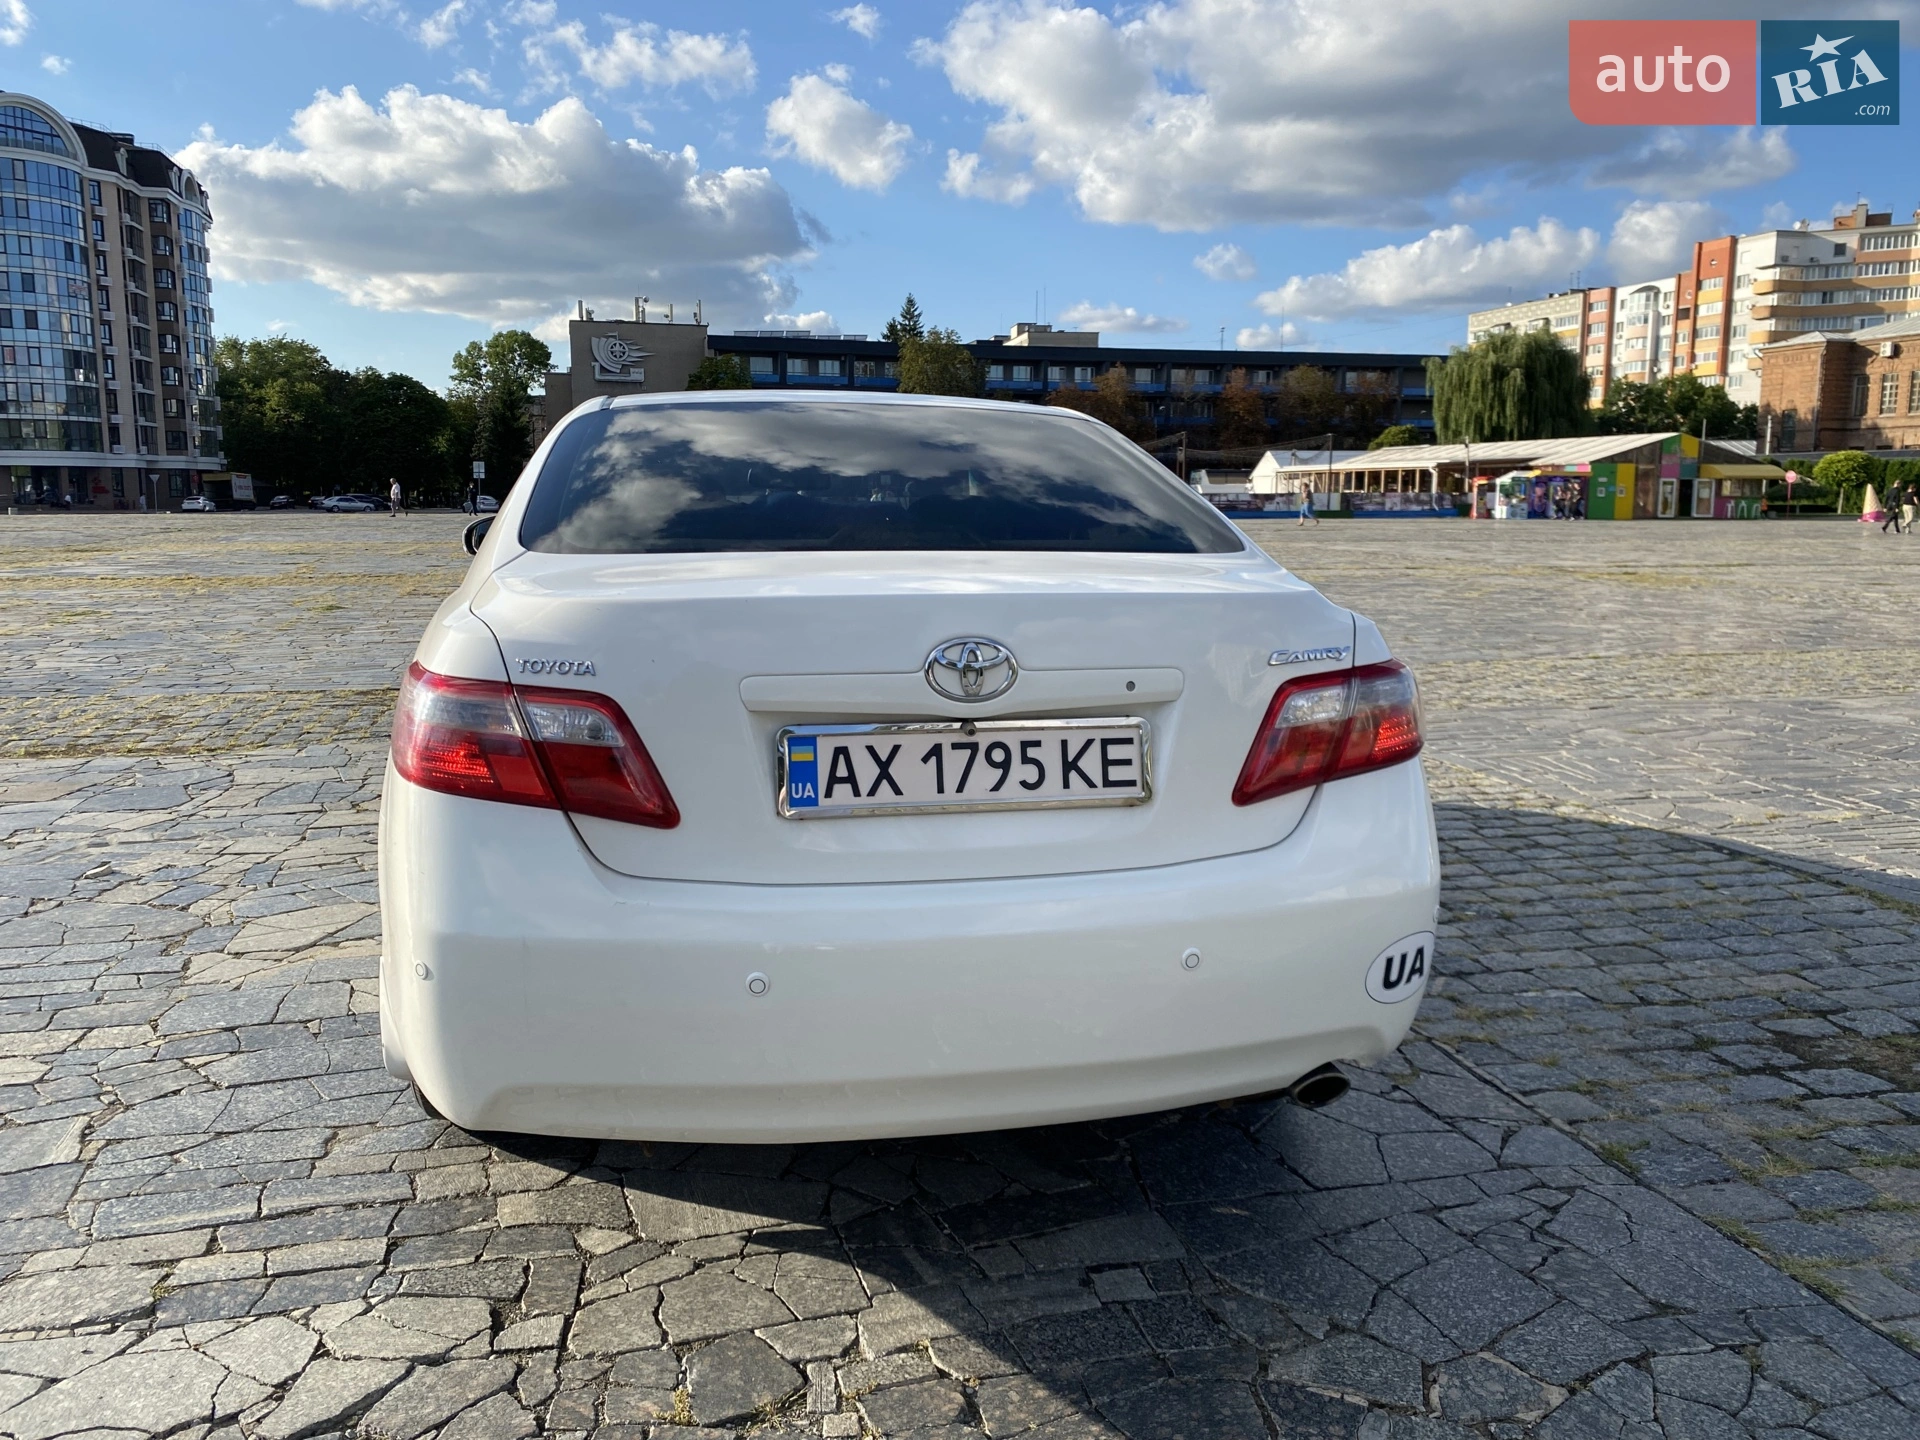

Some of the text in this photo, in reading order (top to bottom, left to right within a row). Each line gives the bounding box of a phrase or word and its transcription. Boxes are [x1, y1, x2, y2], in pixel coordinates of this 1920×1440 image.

[1267, 646, 1351, 666] CAMRY
[515, 658, 596, 676] TOYOTA
[824, 737, 1138, 799] AX 1795 KE
[791, 782, 815, 799] UA
[1382, 945, 1425, 990] UA
